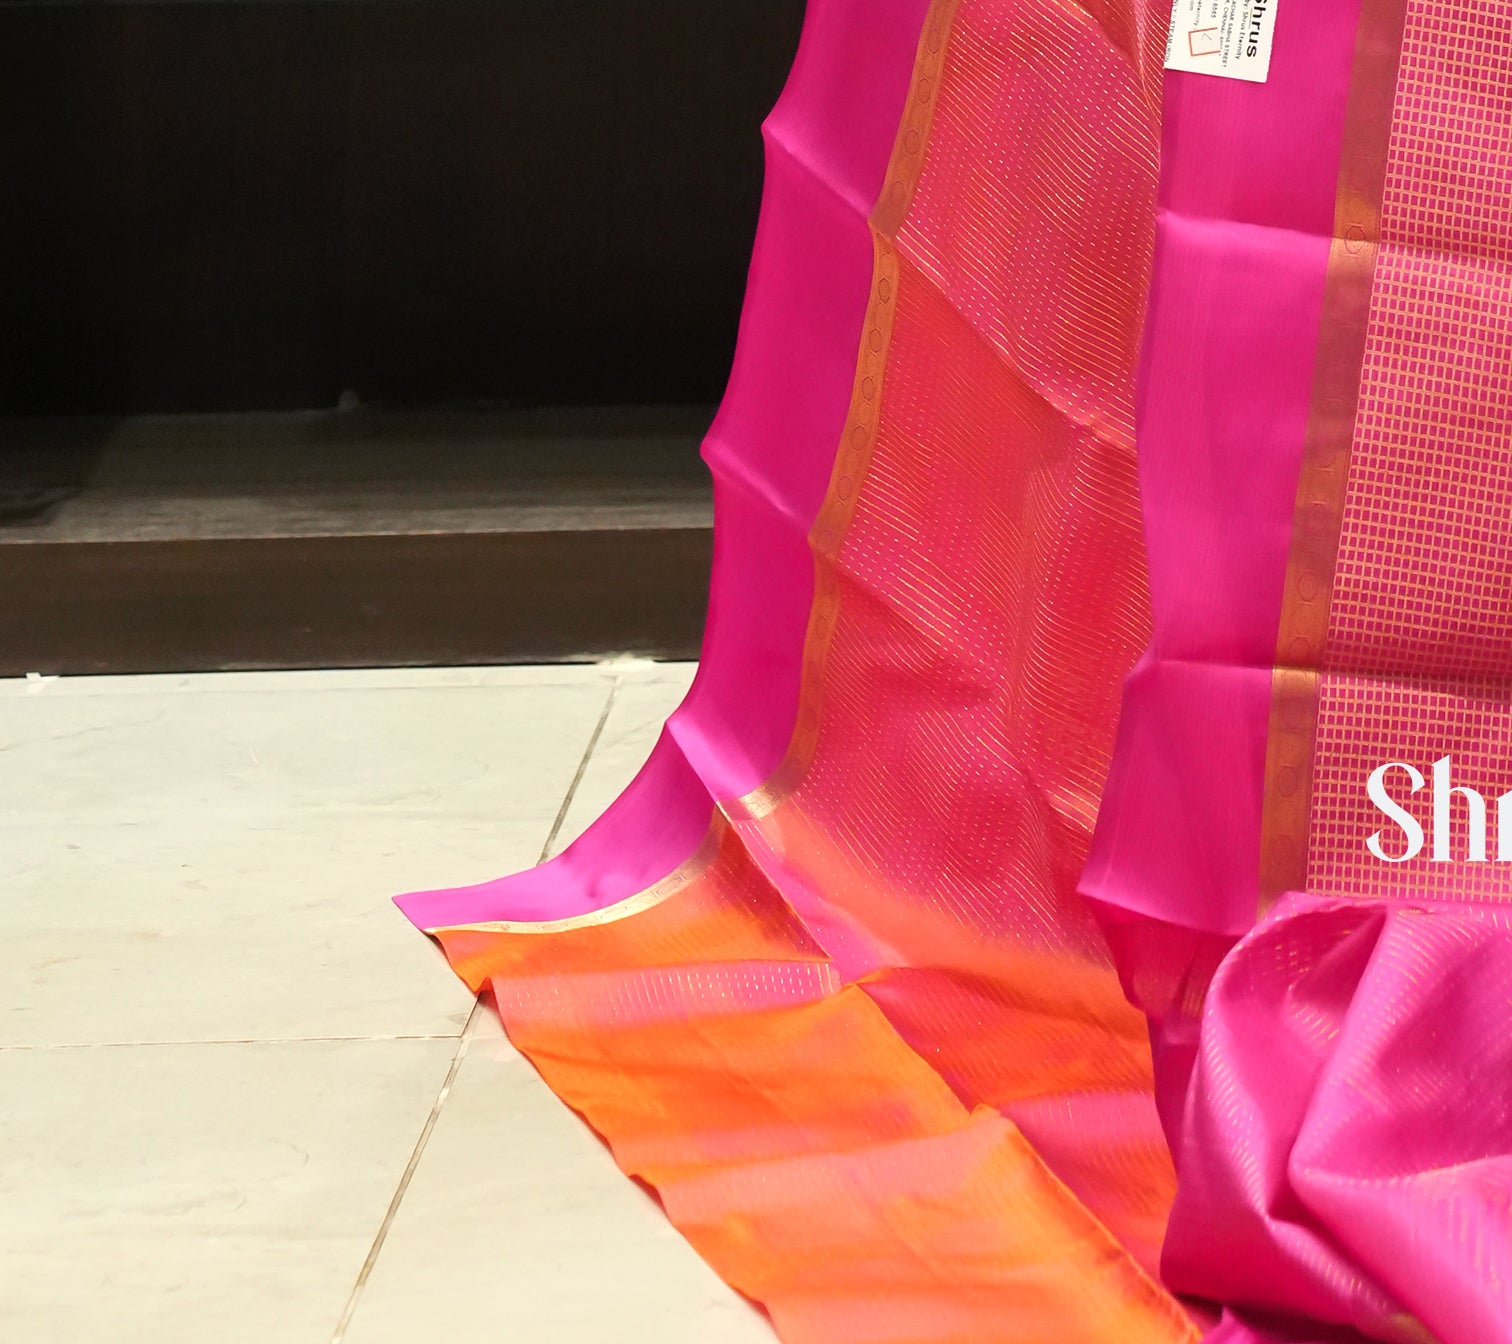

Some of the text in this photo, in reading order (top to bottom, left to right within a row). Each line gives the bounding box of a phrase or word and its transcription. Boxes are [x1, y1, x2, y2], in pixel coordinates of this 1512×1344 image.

[1240, 10, 1248, 30] Shrus
[1221, 44, 1229, 67] STREET
[1234, 31, 1245, 60] Eternity
